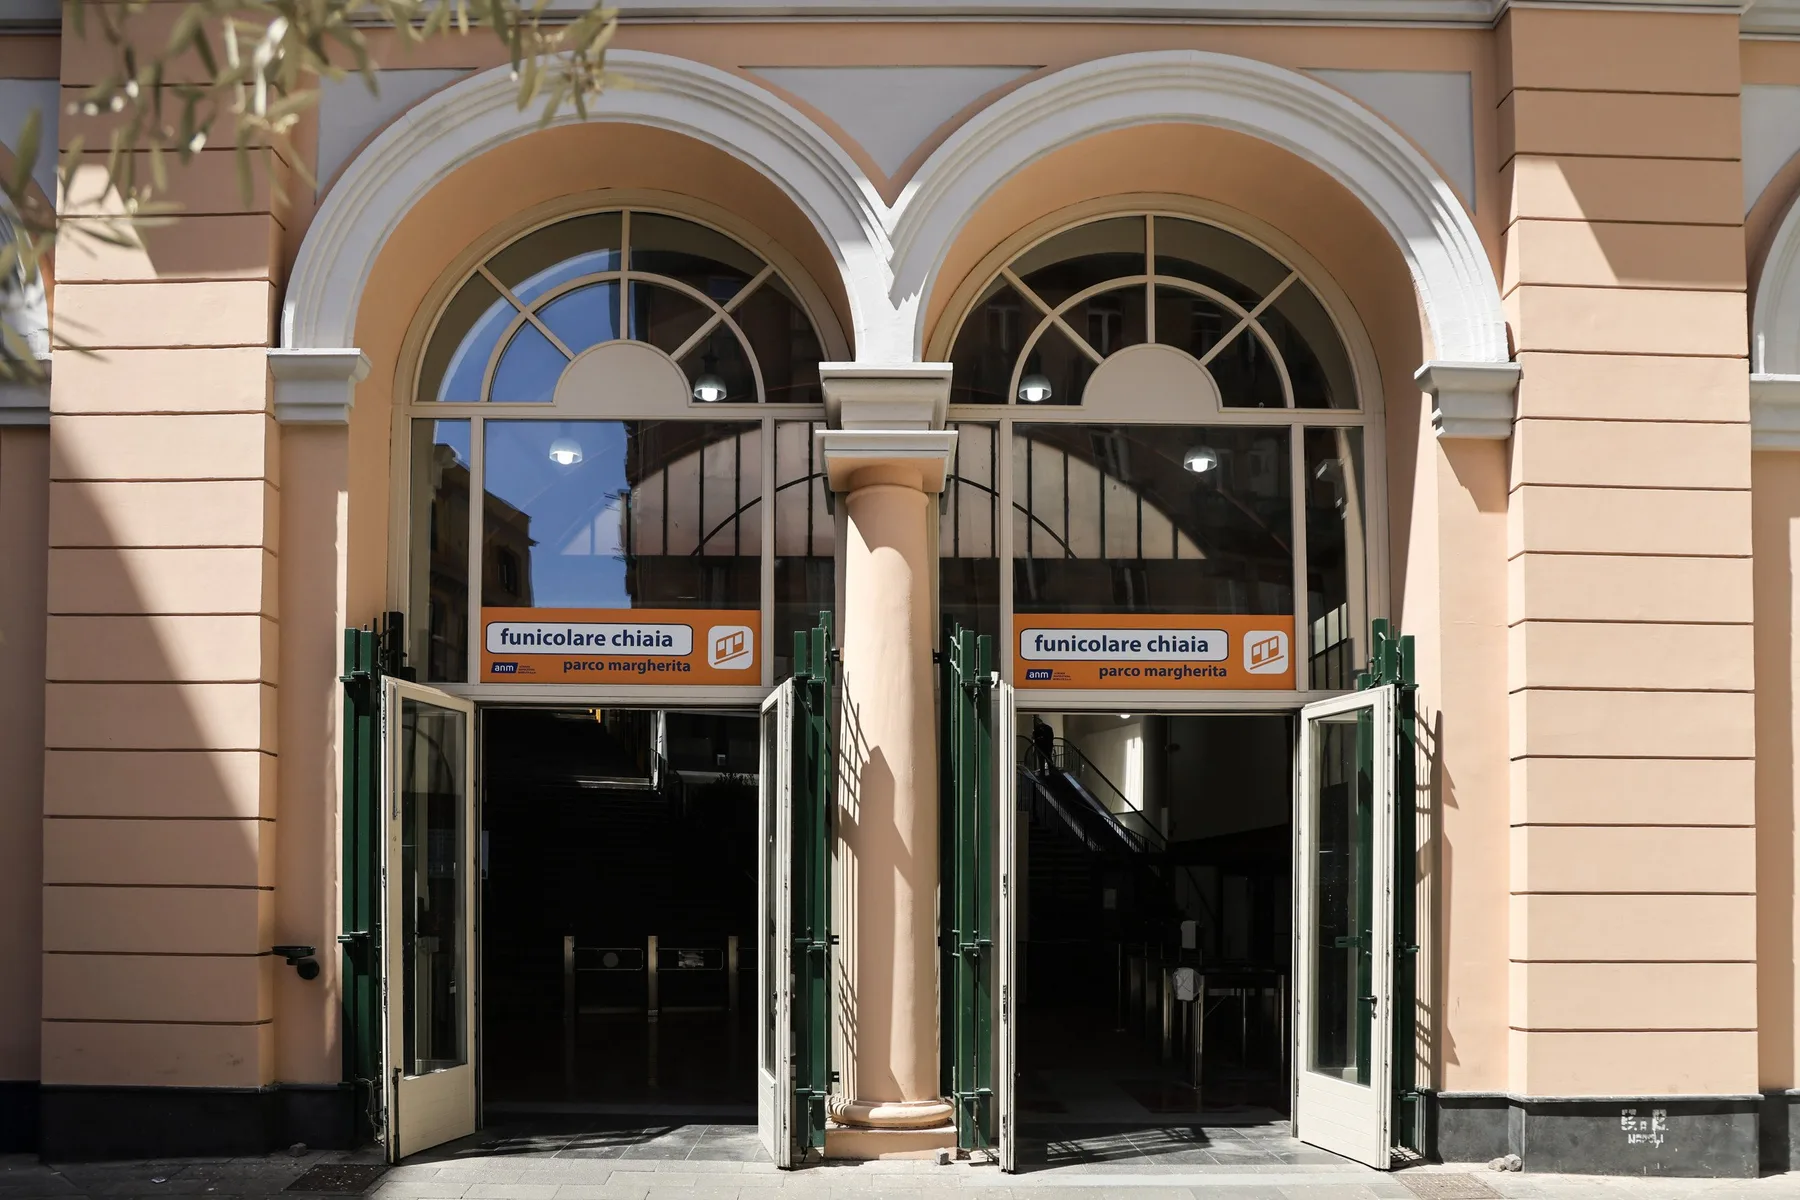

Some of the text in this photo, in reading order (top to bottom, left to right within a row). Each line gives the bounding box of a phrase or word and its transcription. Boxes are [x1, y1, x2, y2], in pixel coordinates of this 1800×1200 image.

[500, 628, 673, 648] funicolare chiaia
[1034, 634, 1209, 653] funicolare chiaia
[494, 664, 514, 672] anm
[563, 660, 691, 674] parco margherita
[1099, 665, 1227, 680] parco margherita
[1029, 671, 1049, 679] anm
